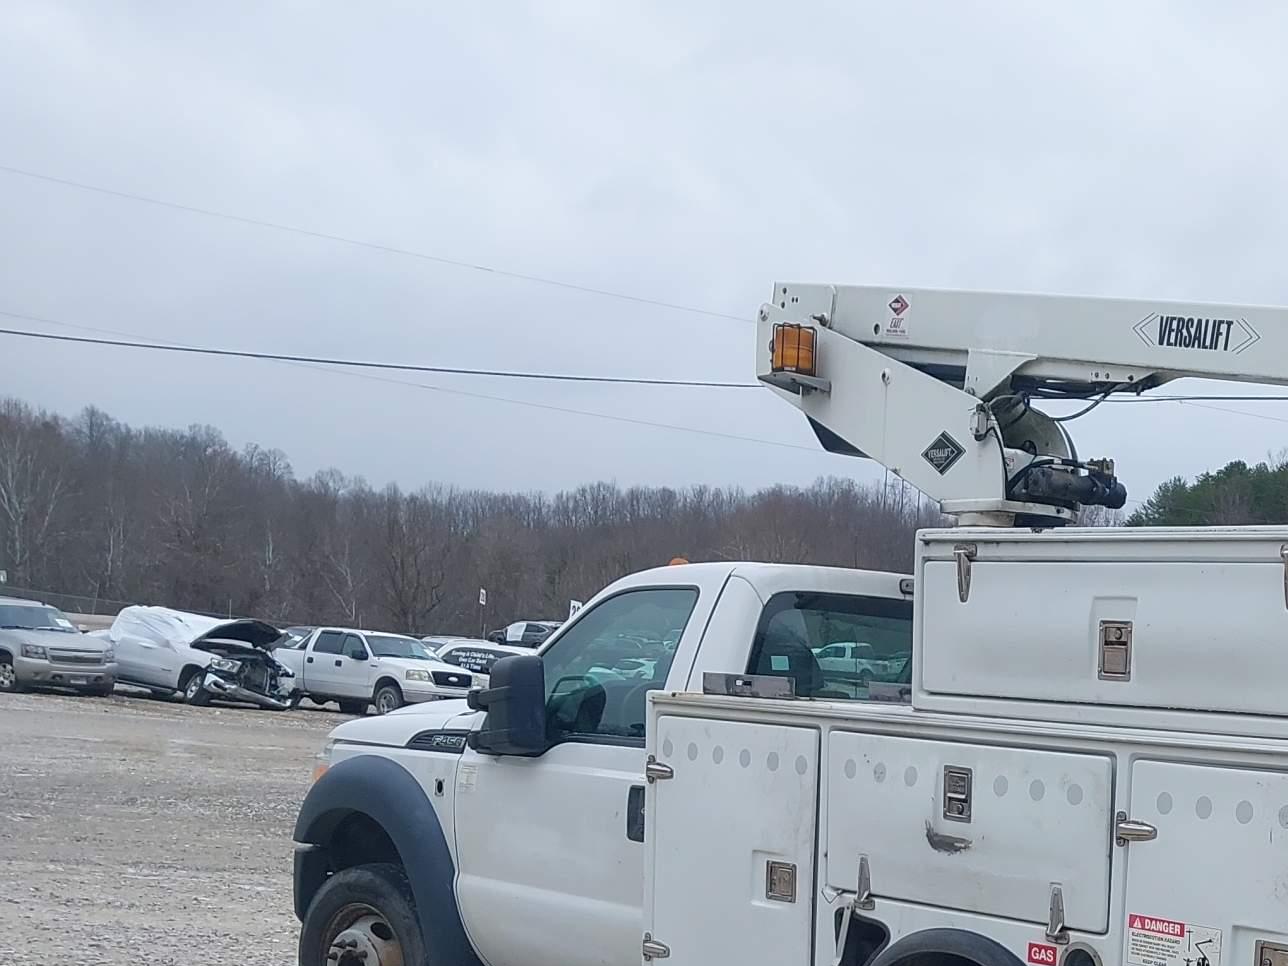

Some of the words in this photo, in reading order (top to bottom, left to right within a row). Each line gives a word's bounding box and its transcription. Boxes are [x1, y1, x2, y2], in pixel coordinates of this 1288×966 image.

[1158, 316, 1234, 351] VERSALIFT
[1144, 919, 1181, 935] DANGER
[1031, 946, 1054, 962] GAS
